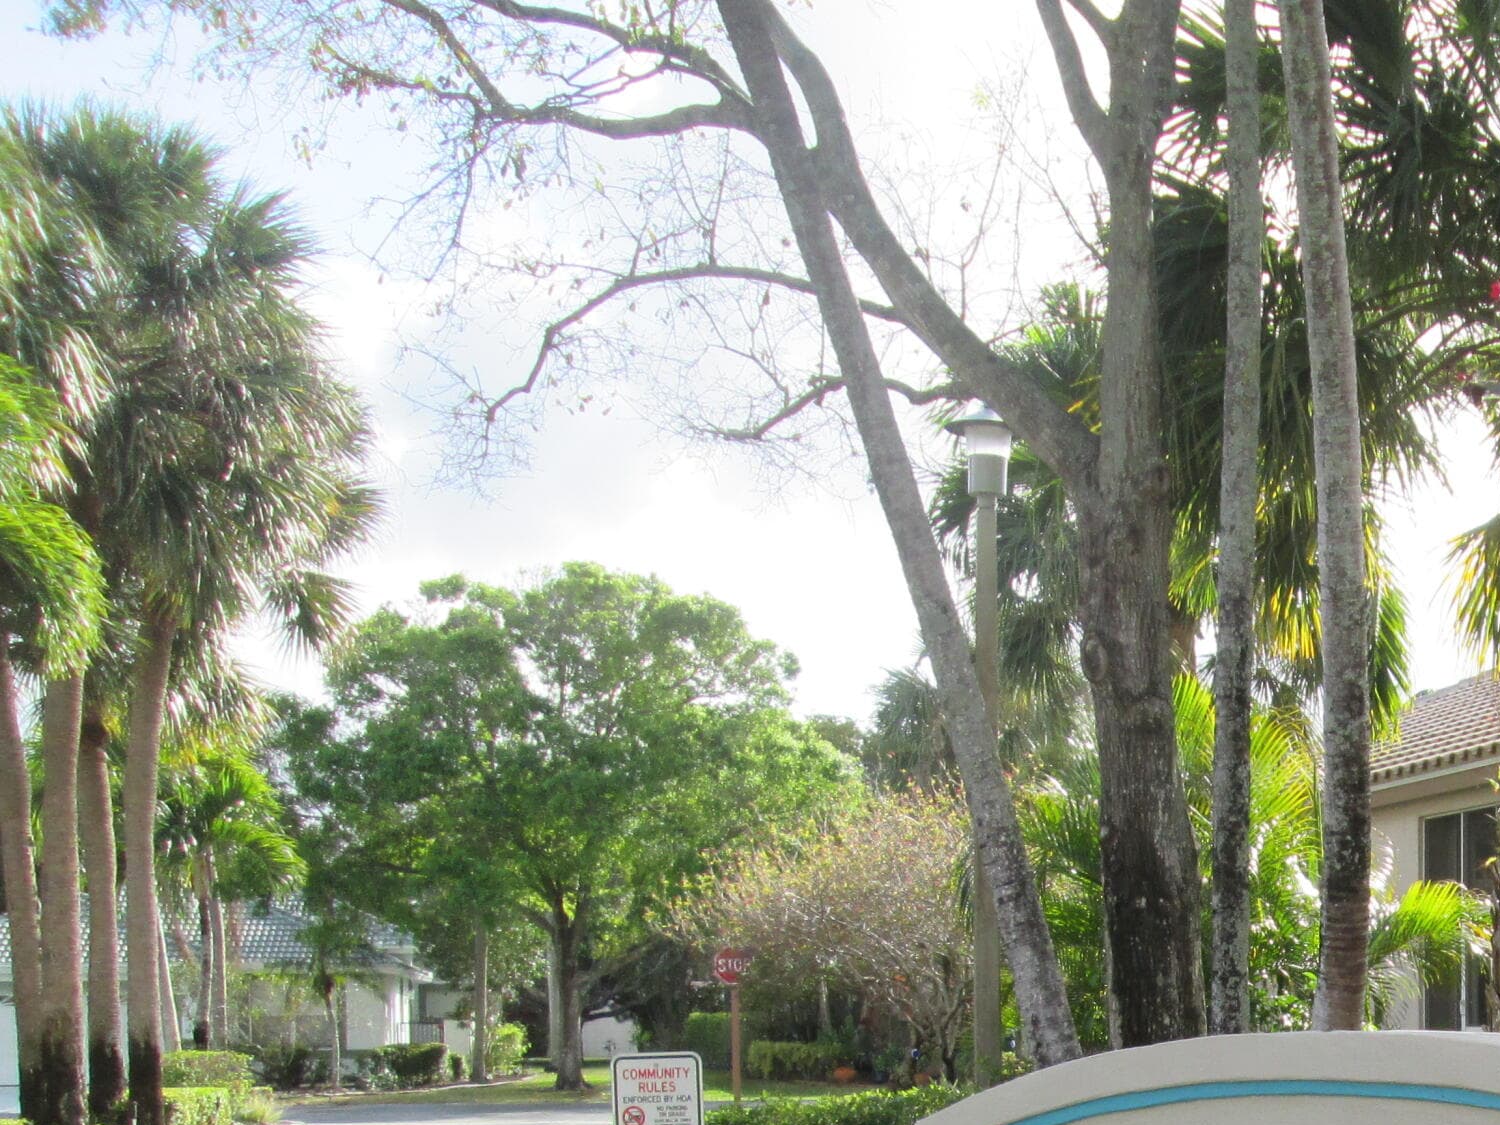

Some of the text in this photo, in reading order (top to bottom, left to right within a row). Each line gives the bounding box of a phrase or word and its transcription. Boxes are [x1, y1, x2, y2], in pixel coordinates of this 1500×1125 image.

[622, 1067, 690, 1080] COMMUNITY
[638, 1081, 676, 1093] RULES
[622, 1094, 692, 1104] ENFORCED BY HOA
